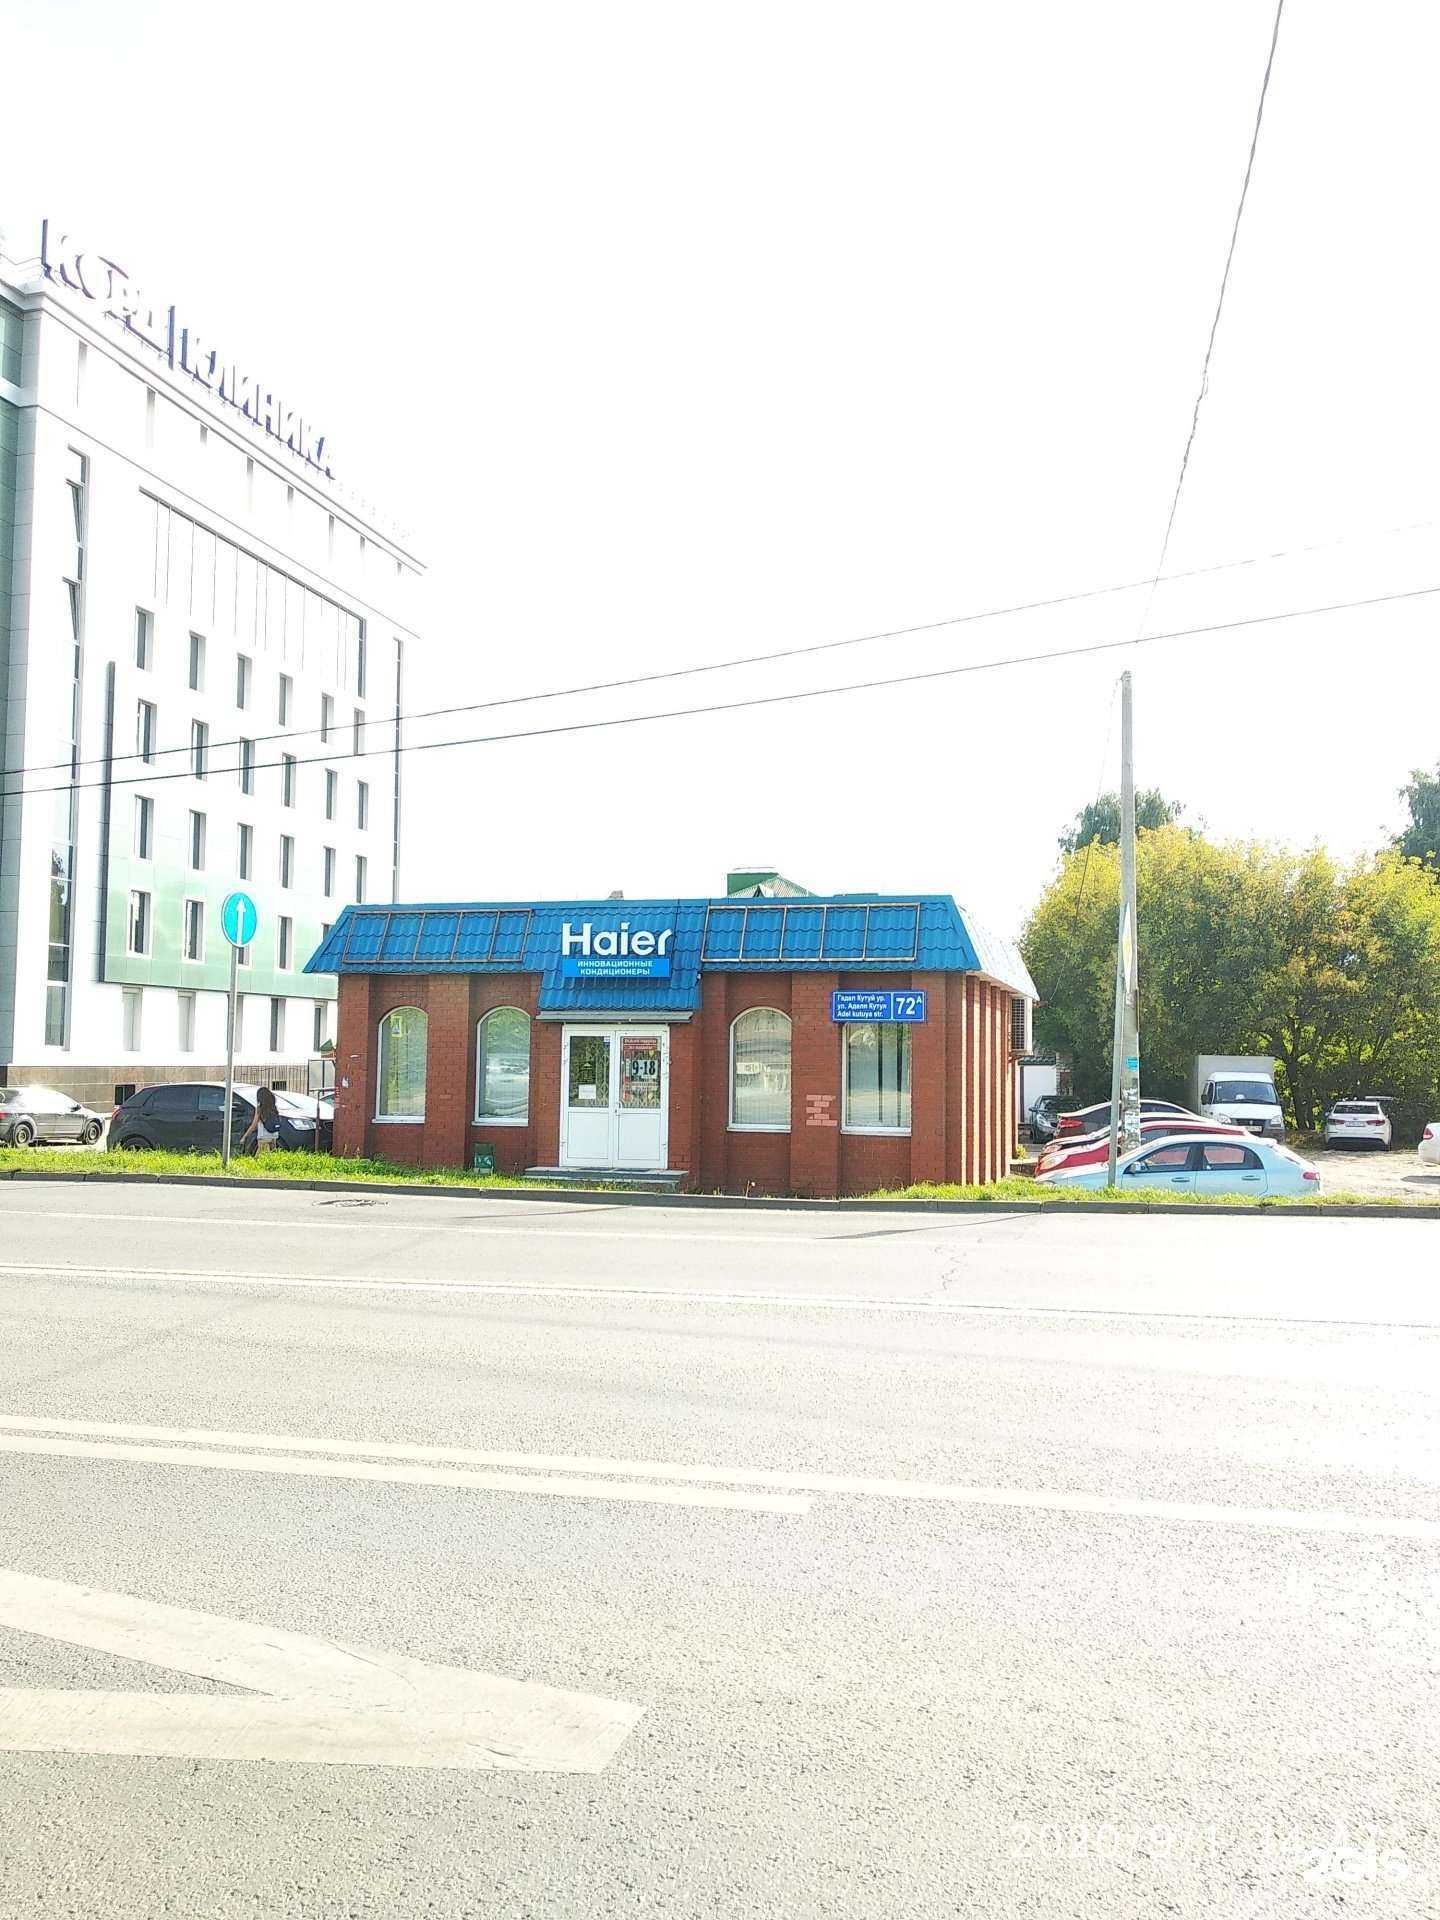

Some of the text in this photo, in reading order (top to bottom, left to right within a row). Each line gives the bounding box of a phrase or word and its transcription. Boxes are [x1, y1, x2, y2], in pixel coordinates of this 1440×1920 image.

[562, 922, 673, 956] Haier
[577, 960, 654, 968] ИННОВАЦИОННЫЕ
[580, 968, 650, 976] КОНДИЦИОНЕРЫ
[632, 1060, 656, 1076] 9-18
